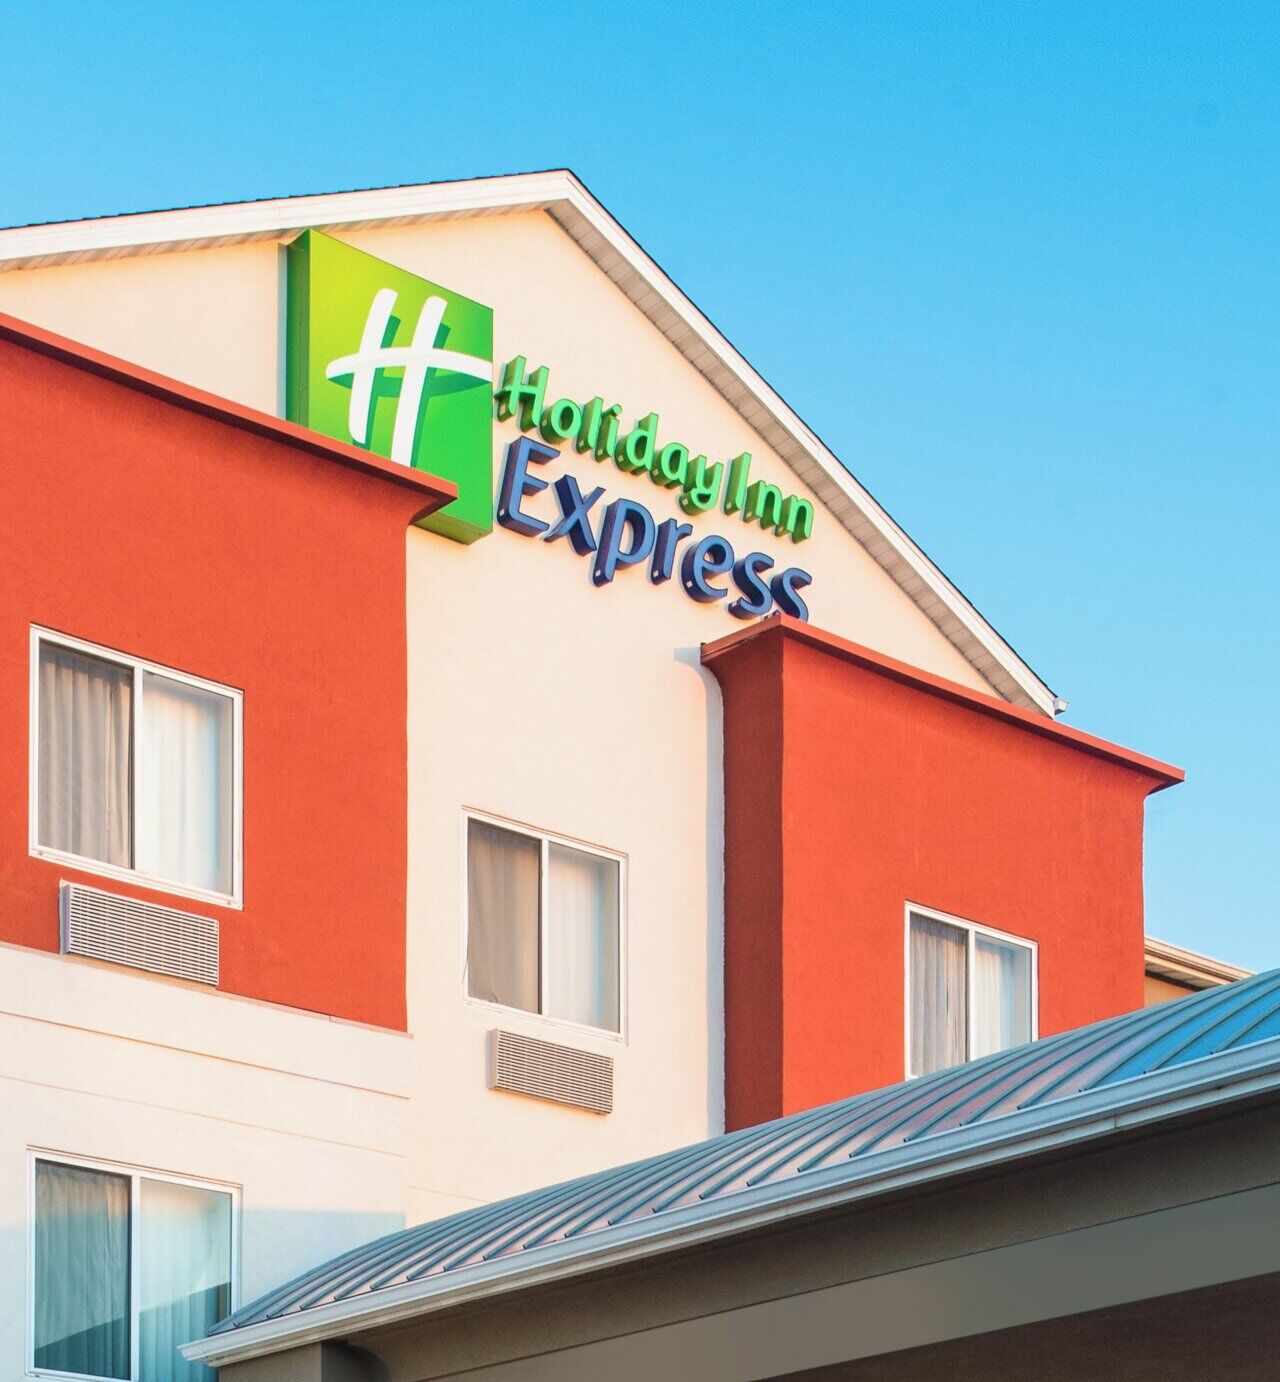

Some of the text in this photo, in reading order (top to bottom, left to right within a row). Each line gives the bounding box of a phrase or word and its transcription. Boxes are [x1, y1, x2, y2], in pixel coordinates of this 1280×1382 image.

[494, 354, 815, 545] Holiday Inn
[496, 435, 814, 624] Express
